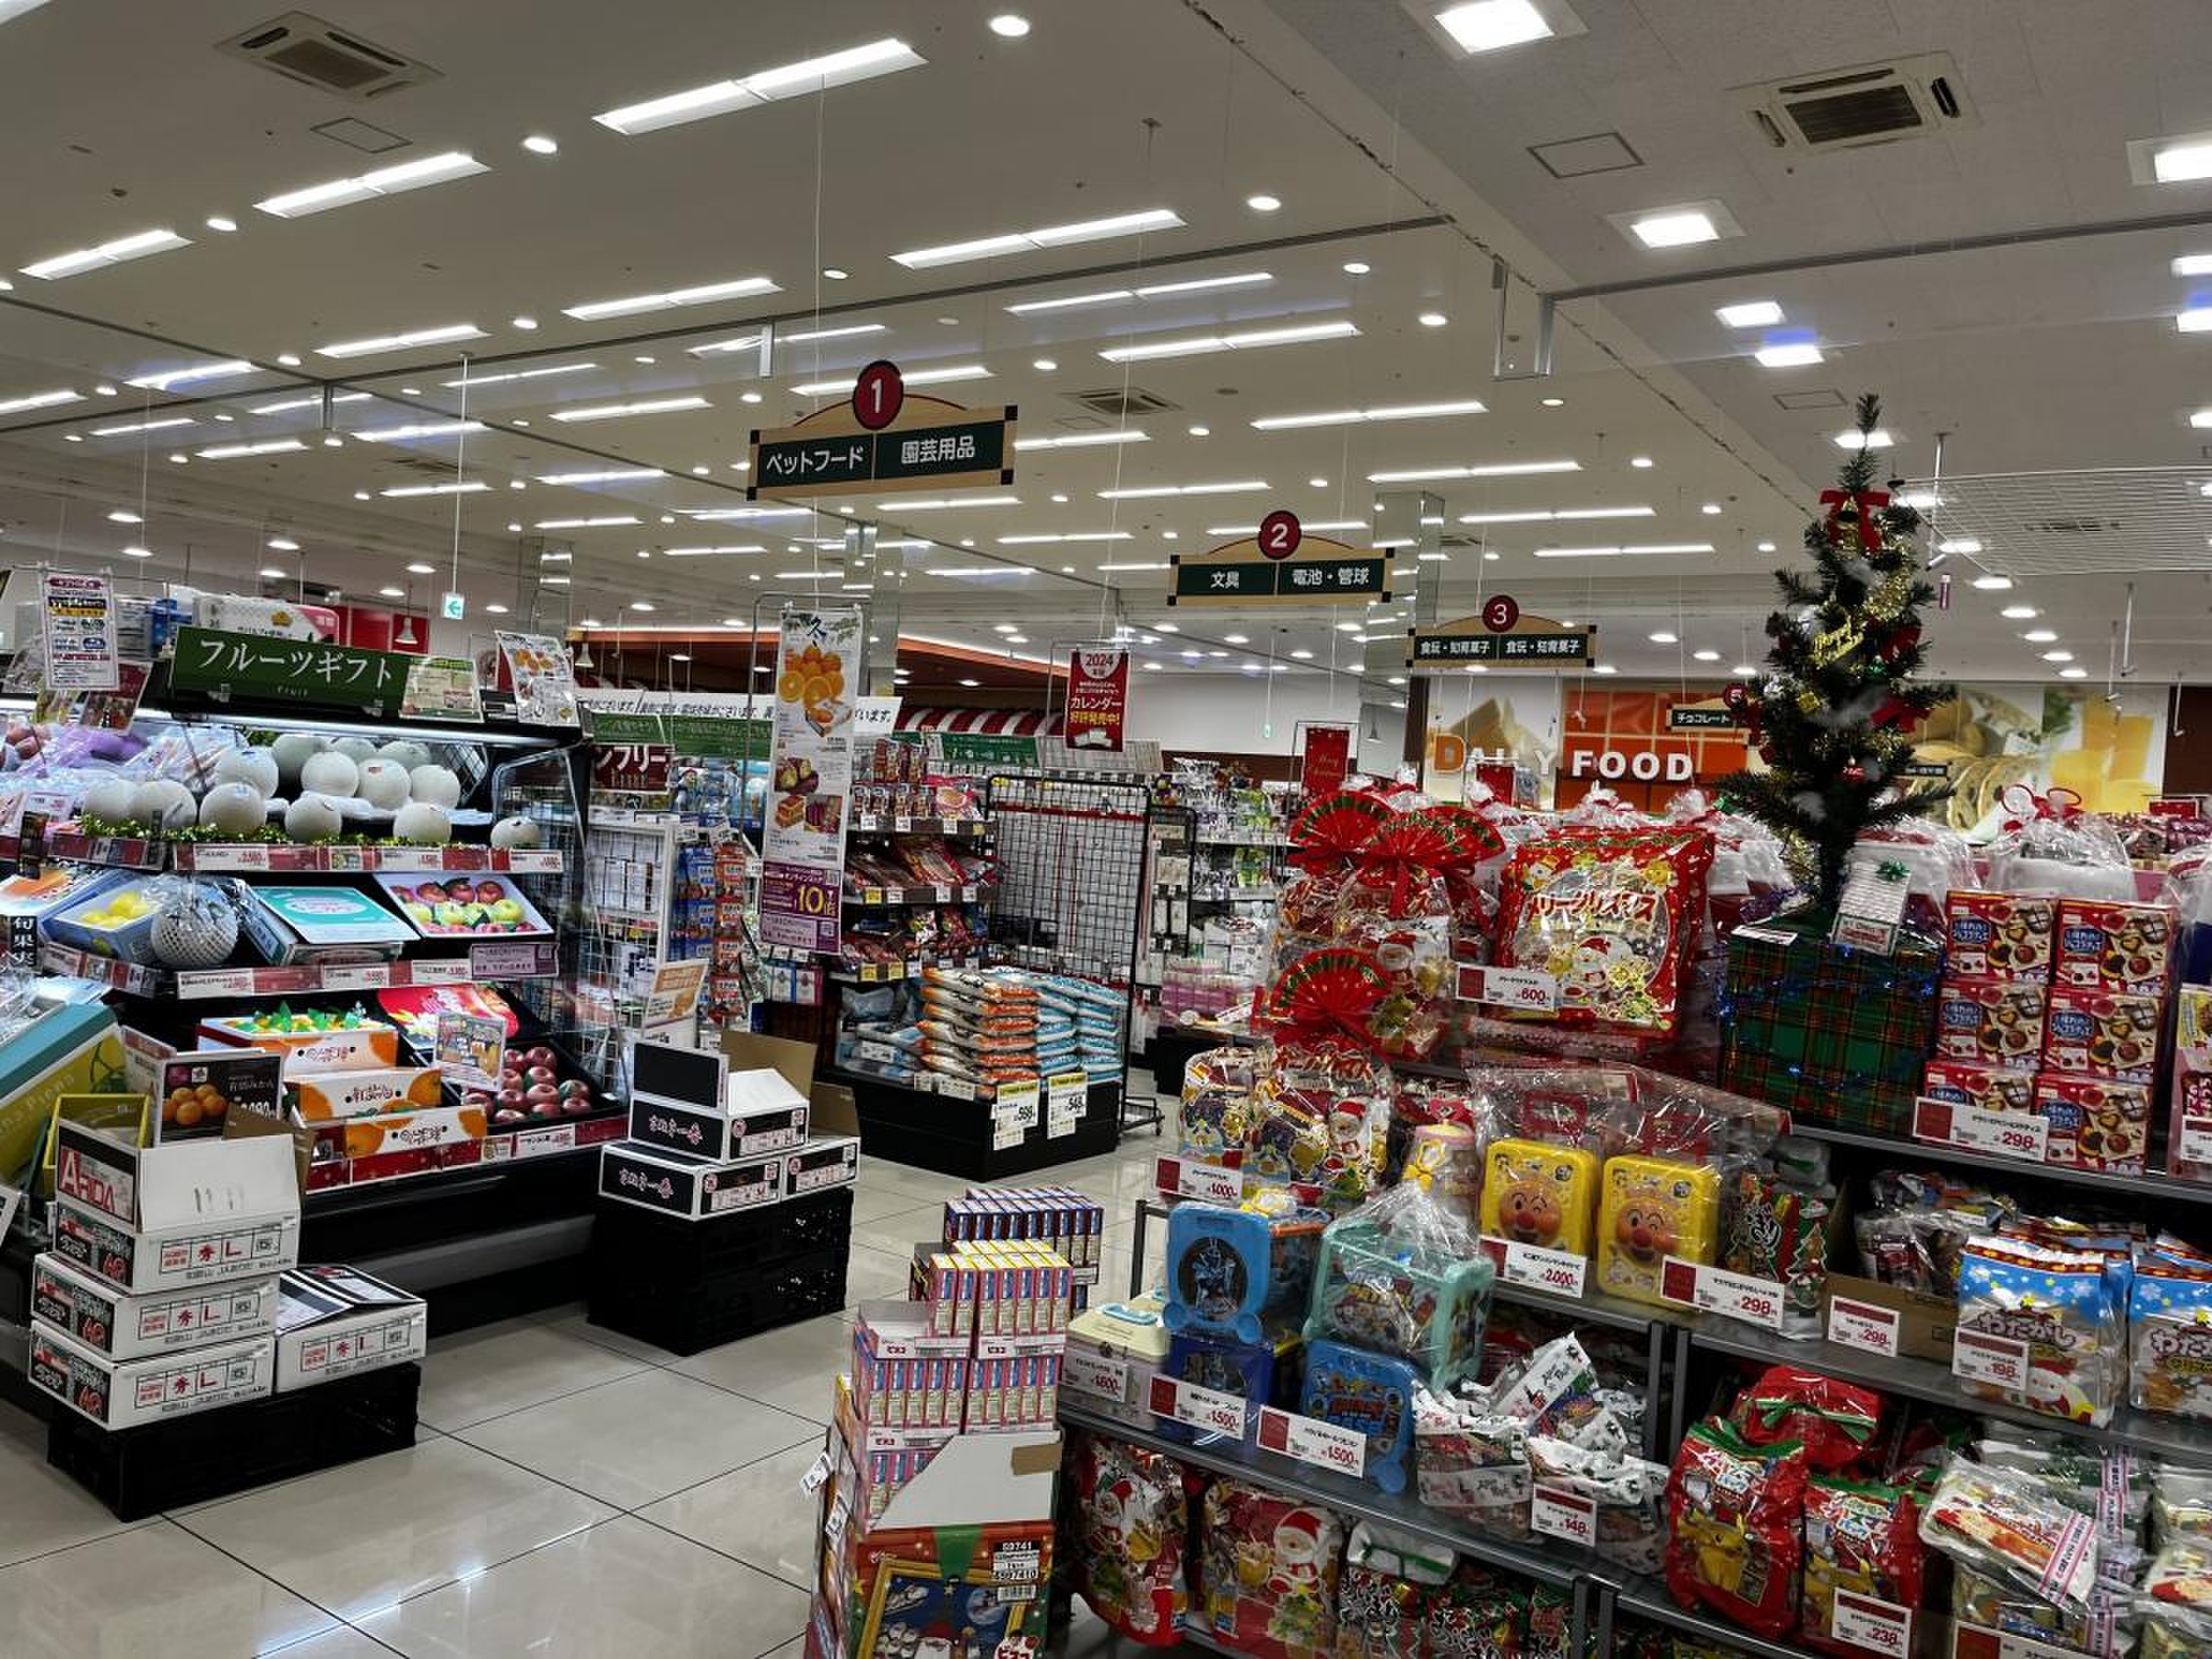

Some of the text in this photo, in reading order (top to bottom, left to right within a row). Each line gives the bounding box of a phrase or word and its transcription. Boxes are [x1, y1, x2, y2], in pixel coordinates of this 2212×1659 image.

[871, 378, 883, 414] 1
[766, 435, 975, 476] ペットフード 園芸用品
[1270, 523, 1288, 548] 2
[1209, 571, 1241, 589] 文具
[1492, 604, 1508, 625] 3
[199, 640, 392, 689] フルーツギフト
[1086, 652, 1114, 665] 2024
[1070, 695, 1123, 710] カレンダー
[1677, 712, 1731, 724] チョコレート
[1571, 749, 1694, 782] FOOD
[1526, 888, 1657, 922] メリークリスマス
[1977, 1310, 2077, 1348] わたがし
[2149, 1325, 2212, 1357] わた
